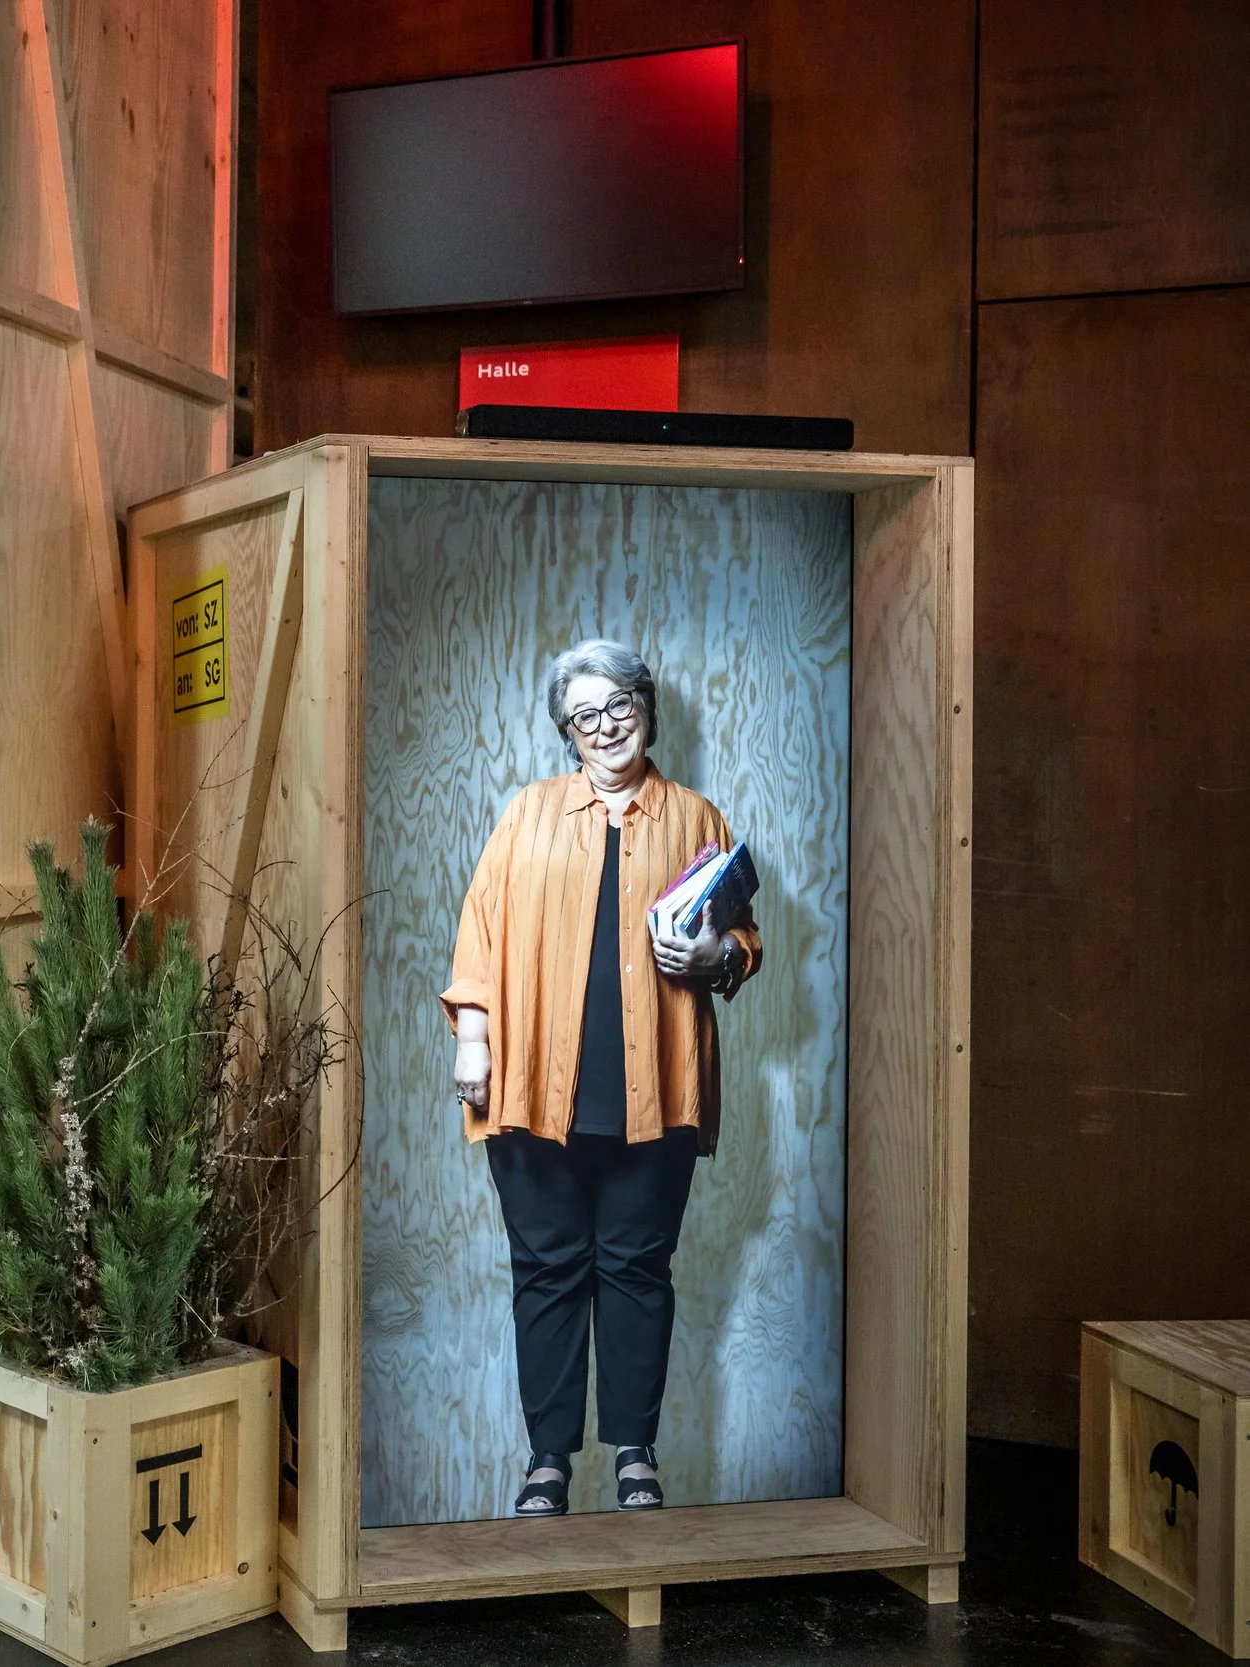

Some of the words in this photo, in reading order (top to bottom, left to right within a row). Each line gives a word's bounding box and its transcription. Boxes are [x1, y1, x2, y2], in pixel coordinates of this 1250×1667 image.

[478, 361, 529, 379] Halle
[176, 612, 199, 640] von:
[204, 599, 218, 630] SZ
[177, 672, 193, 696] an:
[205, 657, 221, 688] SG
